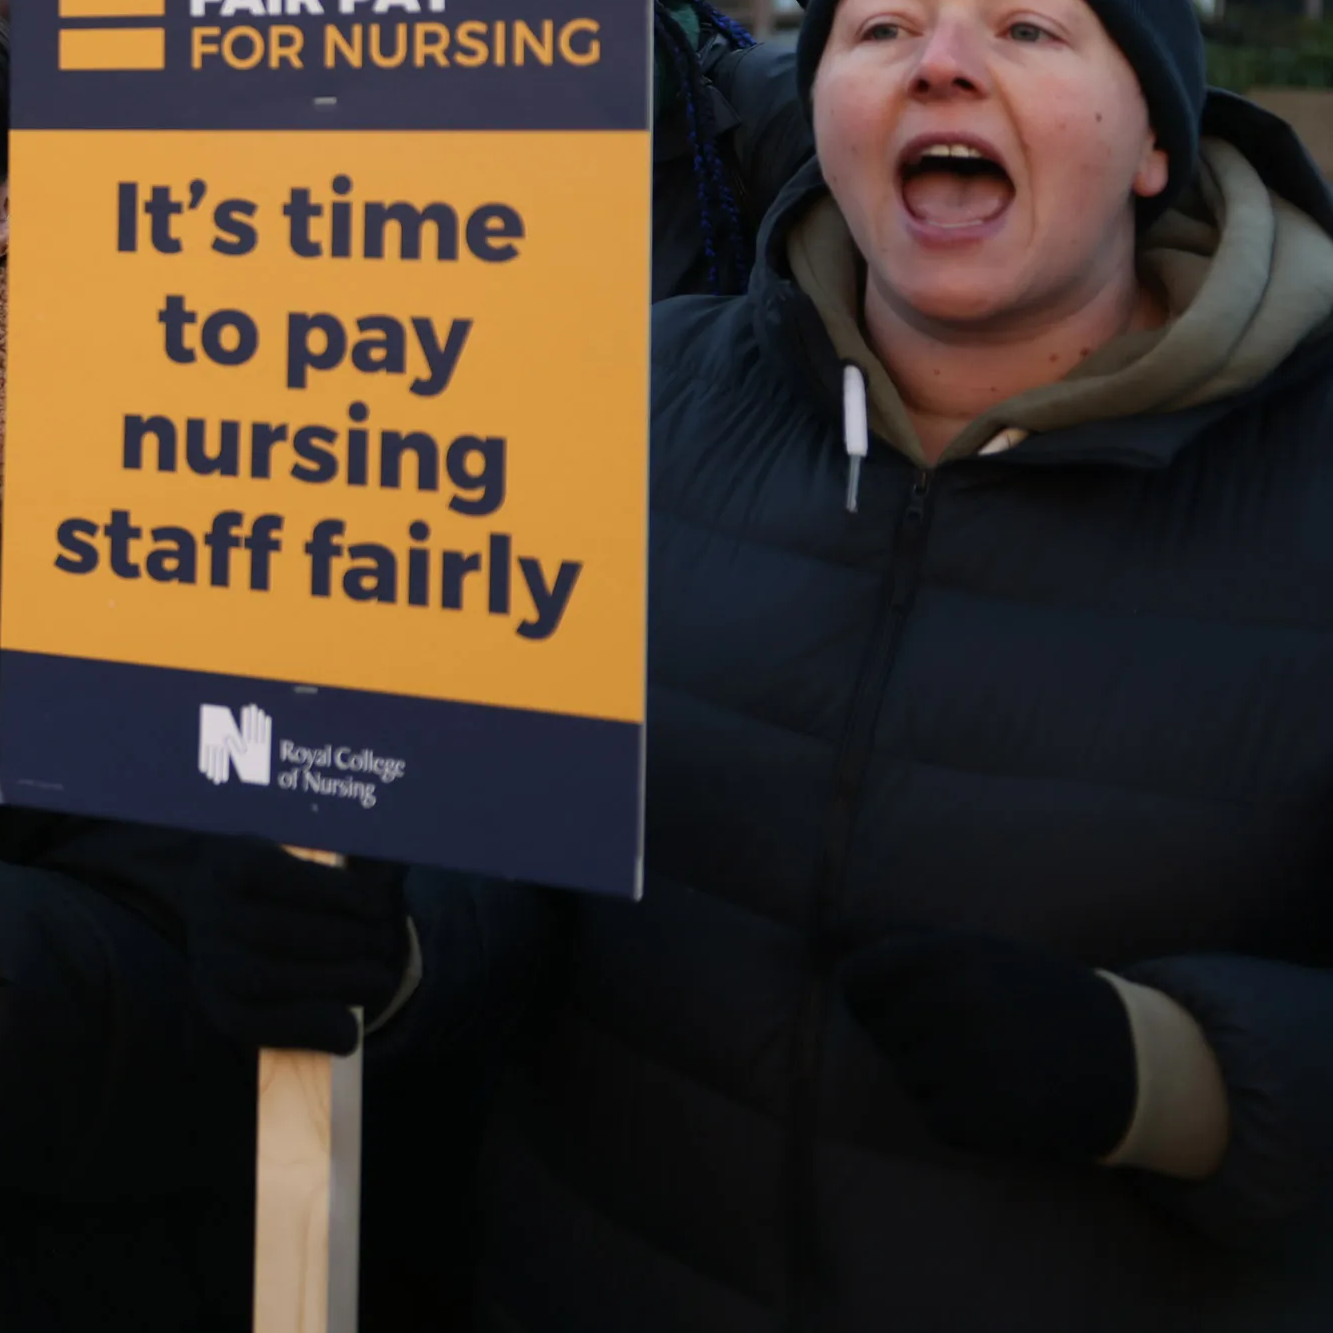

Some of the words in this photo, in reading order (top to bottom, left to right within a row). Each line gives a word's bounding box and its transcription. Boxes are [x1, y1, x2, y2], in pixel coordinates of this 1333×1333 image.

[190, 26, 305, 70] FOR
[324, 18, 601, 68] NURSING
[116, 178, 259, 256] It's
[282, 174, 526, 263] time
[157, 294, 259, 365] to
[286, 311, 474, 397] pay
[122, 401, 508, 516] nursing
[54, 509, 285, 592] staff
[304, 519, 584, 641] fairly
[277, 769, 301, 789] of
[302, 770, 377, 808] Nursing
[279, 740, 332, 770] Royal
[333, 748, 406, 782] College
